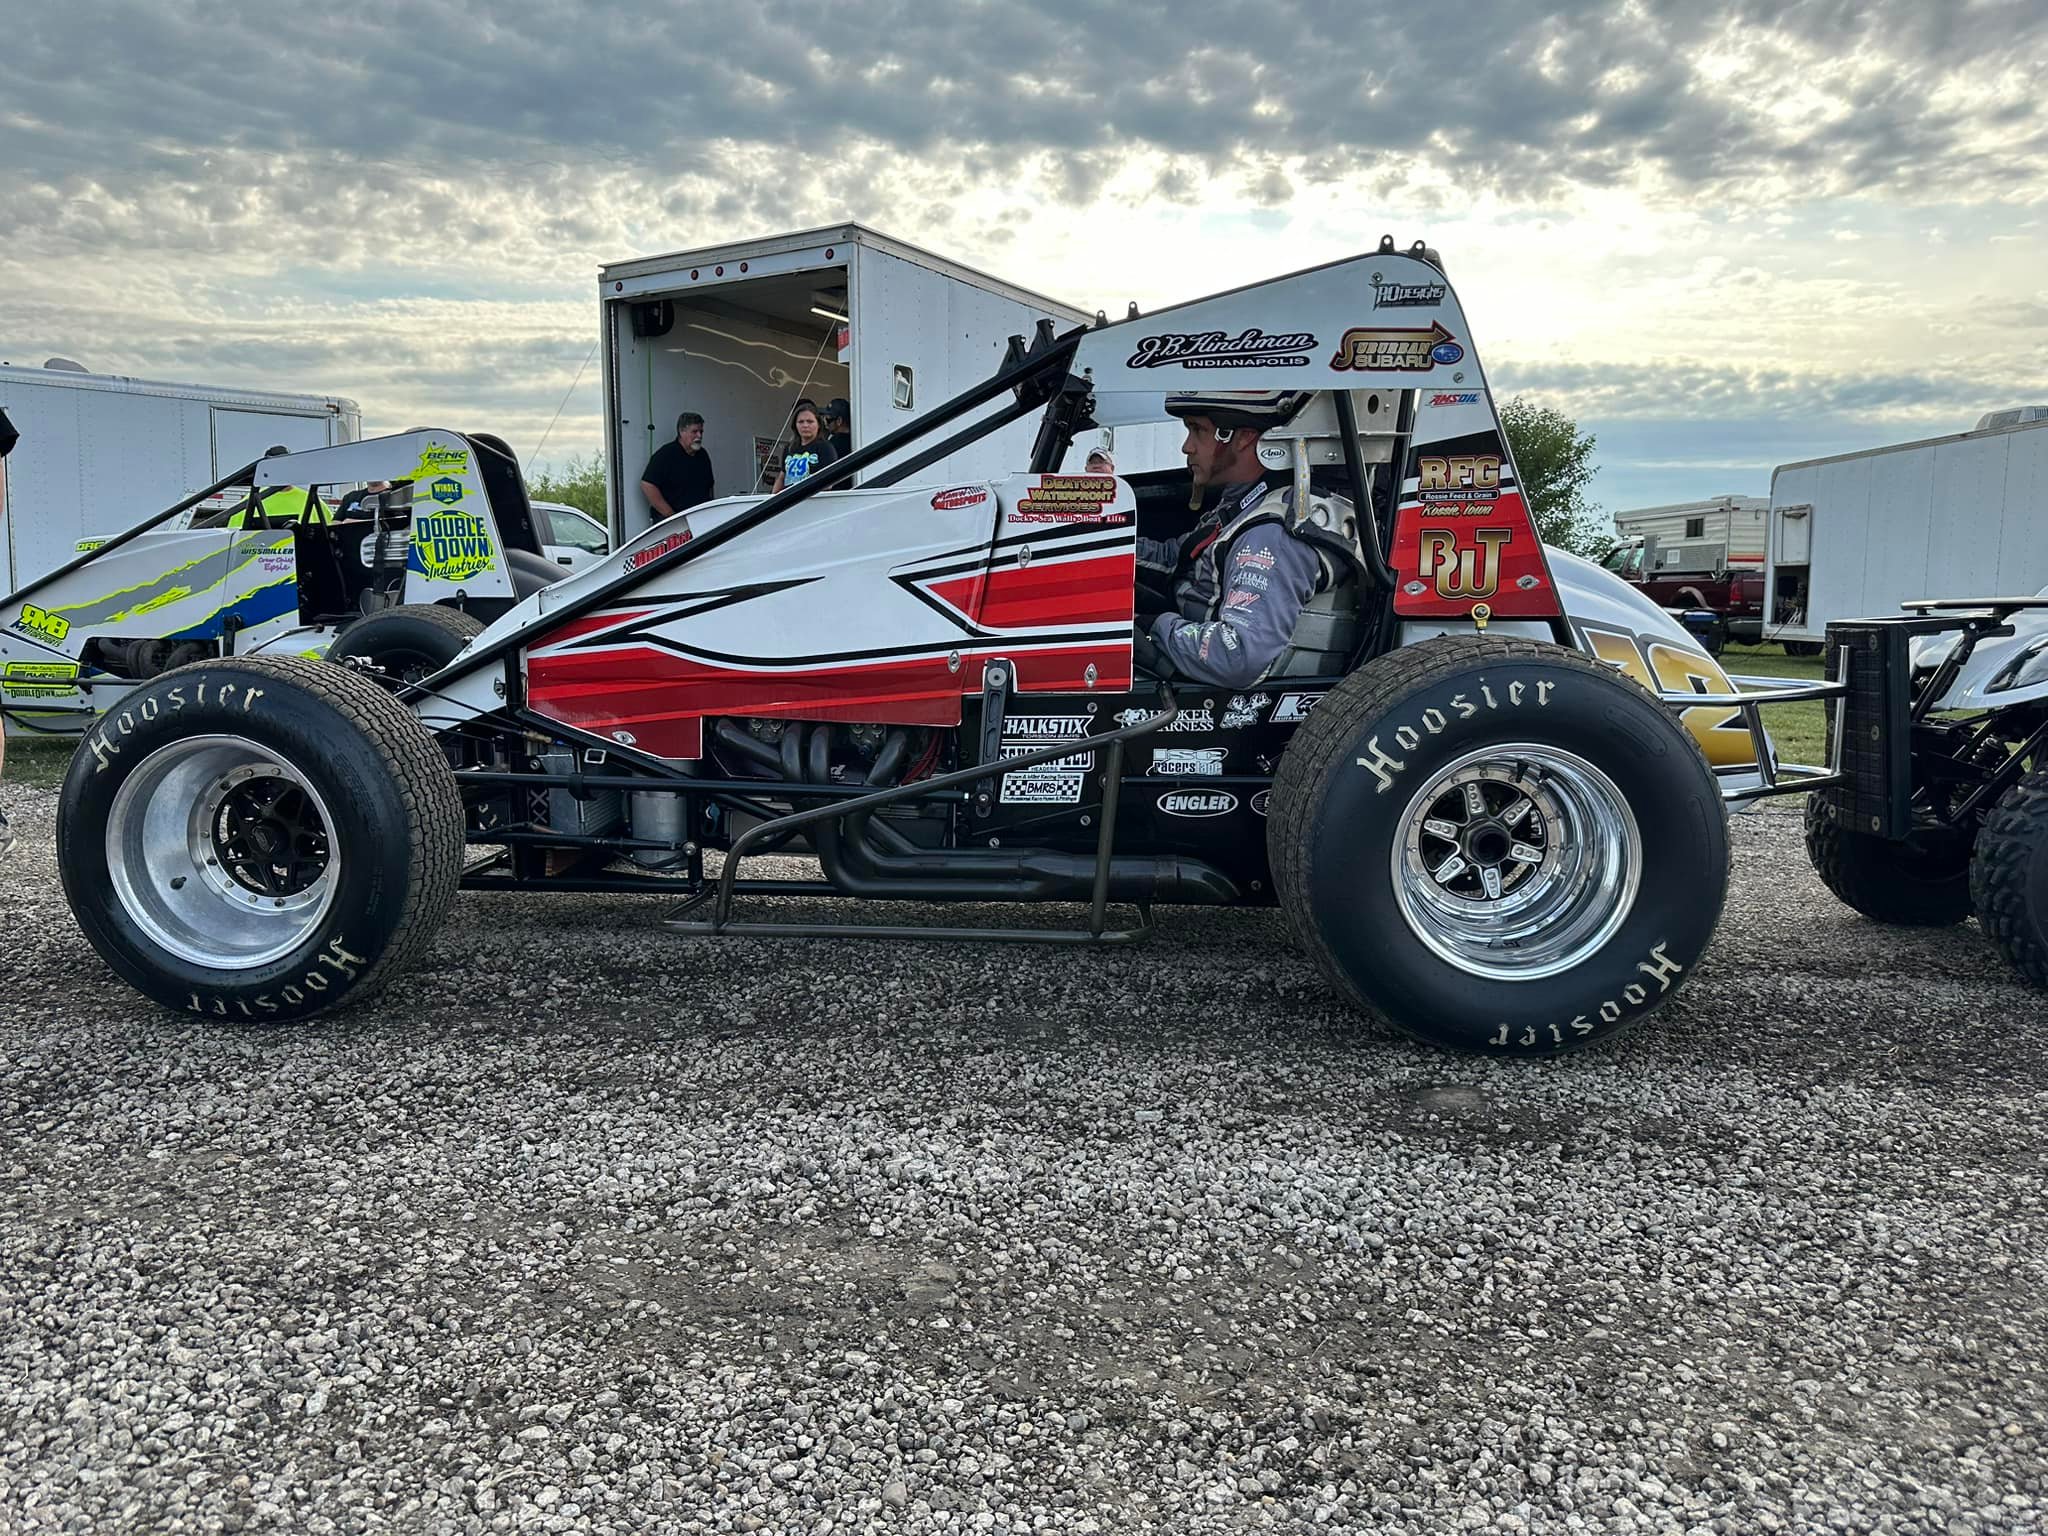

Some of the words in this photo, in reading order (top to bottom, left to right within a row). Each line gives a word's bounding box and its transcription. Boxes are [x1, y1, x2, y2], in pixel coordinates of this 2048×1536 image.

[1181, 329, 1314, 355] Hinchman
[1187, 358, 1306, 367] INDIANAPOLIS
[1354, 354, 1432, 368] SUBARU
[1429, 392, 1480, 406] AMSOIL
[1042, 477, 1113, 489] DEATON'S
[1420, 456, 1500, 490] RFG
[1030, 490, 1113, 500] WATERFRONT
[415, 517, 486, 543] DOUBLE
[433, 537, 490, 564] DOWN
[429, 558, 488, 579] Industries
[89, 676, 265, 773] Hoosier
[1003, 719, 1085, 734] HALKSTIX
[1356, 676, 1556, 795] Hoosier
[1026, 782, 1057, 794] BMRS
[1165, 796, 1231, 810] ENGLER
[188, 935, 368, 1017] Hoosier
[1488, 940, 1684, 1048] Hoosier
